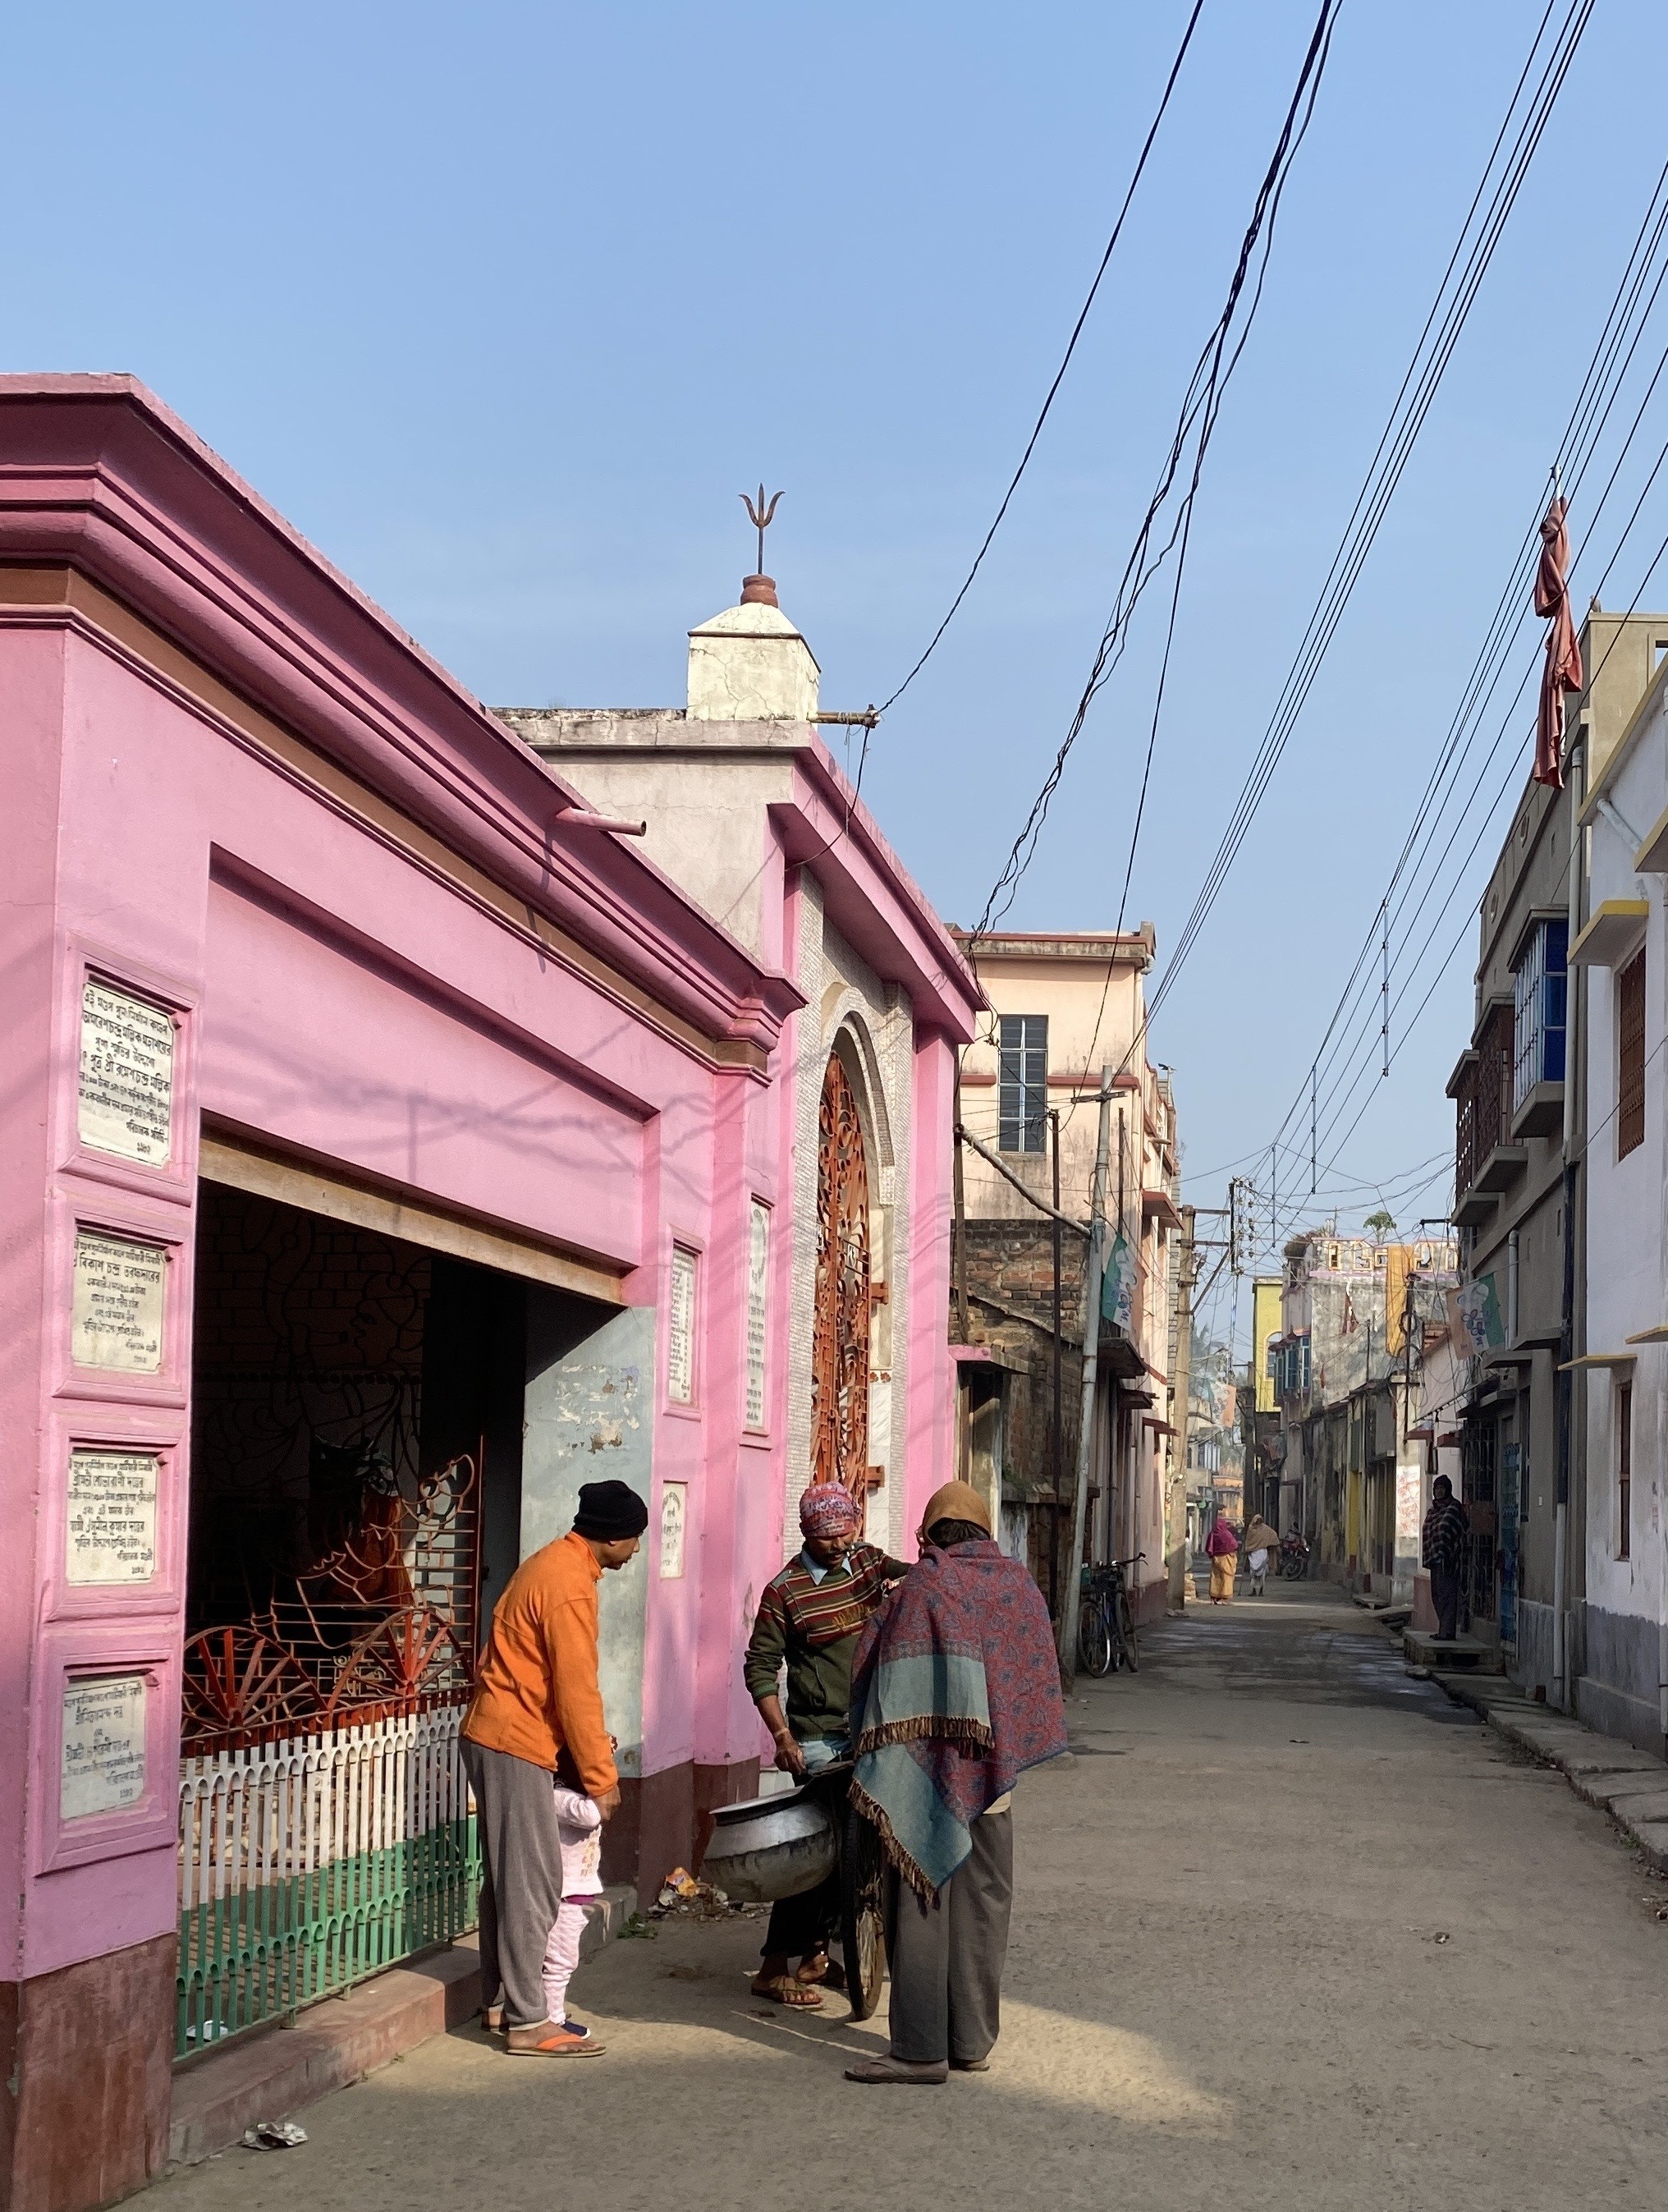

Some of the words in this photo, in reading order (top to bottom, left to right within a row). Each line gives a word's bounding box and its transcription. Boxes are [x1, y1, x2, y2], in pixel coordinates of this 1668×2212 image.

[84, 987, 94, 1007] এই
[104, 1053, 115, 1072] শ্রী
[80, 1252, 103, 1272] বিকাশ
[107, 1262, 121, 1276] চন্দ্র
